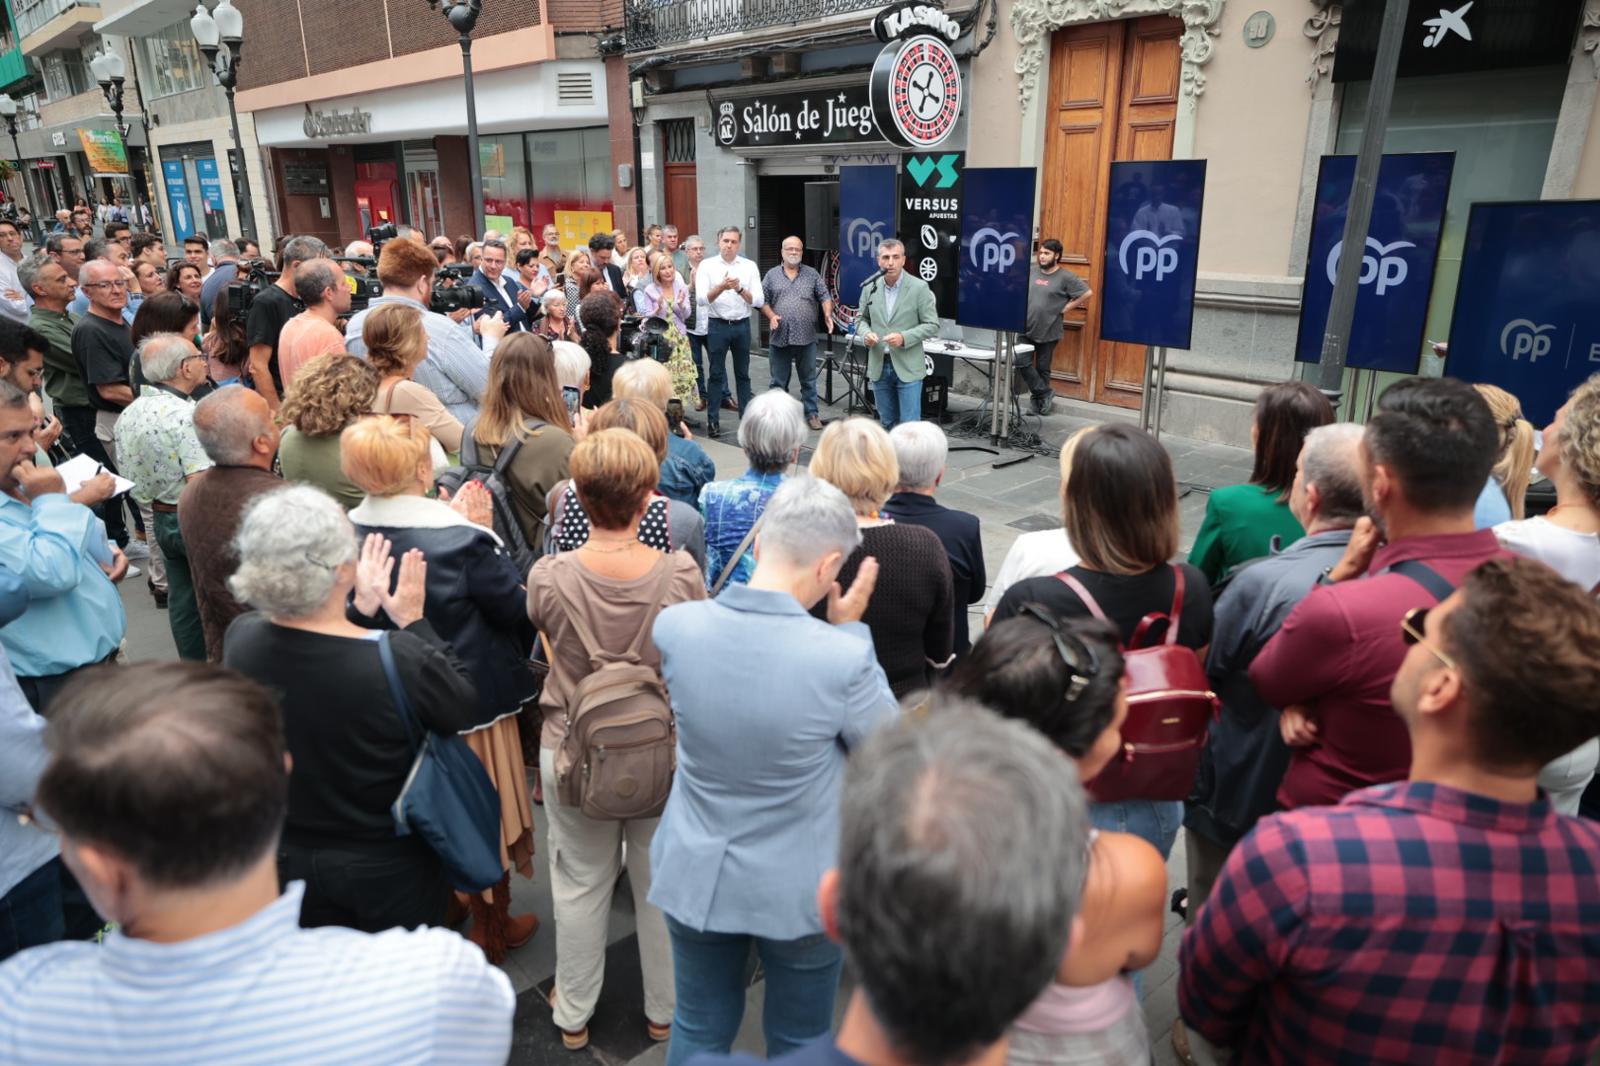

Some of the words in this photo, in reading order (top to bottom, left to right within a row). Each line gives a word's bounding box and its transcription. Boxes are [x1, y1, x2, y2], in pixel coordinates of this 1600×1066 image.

[883, 5, 961, 40] KASINO
[743, 104, 792, 134] Salón
[797, 99, 820, 130] de
[823, 99, 872, 137] Jueg
[905, 198, 958, 211] VERSUS
[983, 242, 1016, 274] pp
[1135, 246, 1178, 282] pp
[1512, 332, 1551, 363] pp
